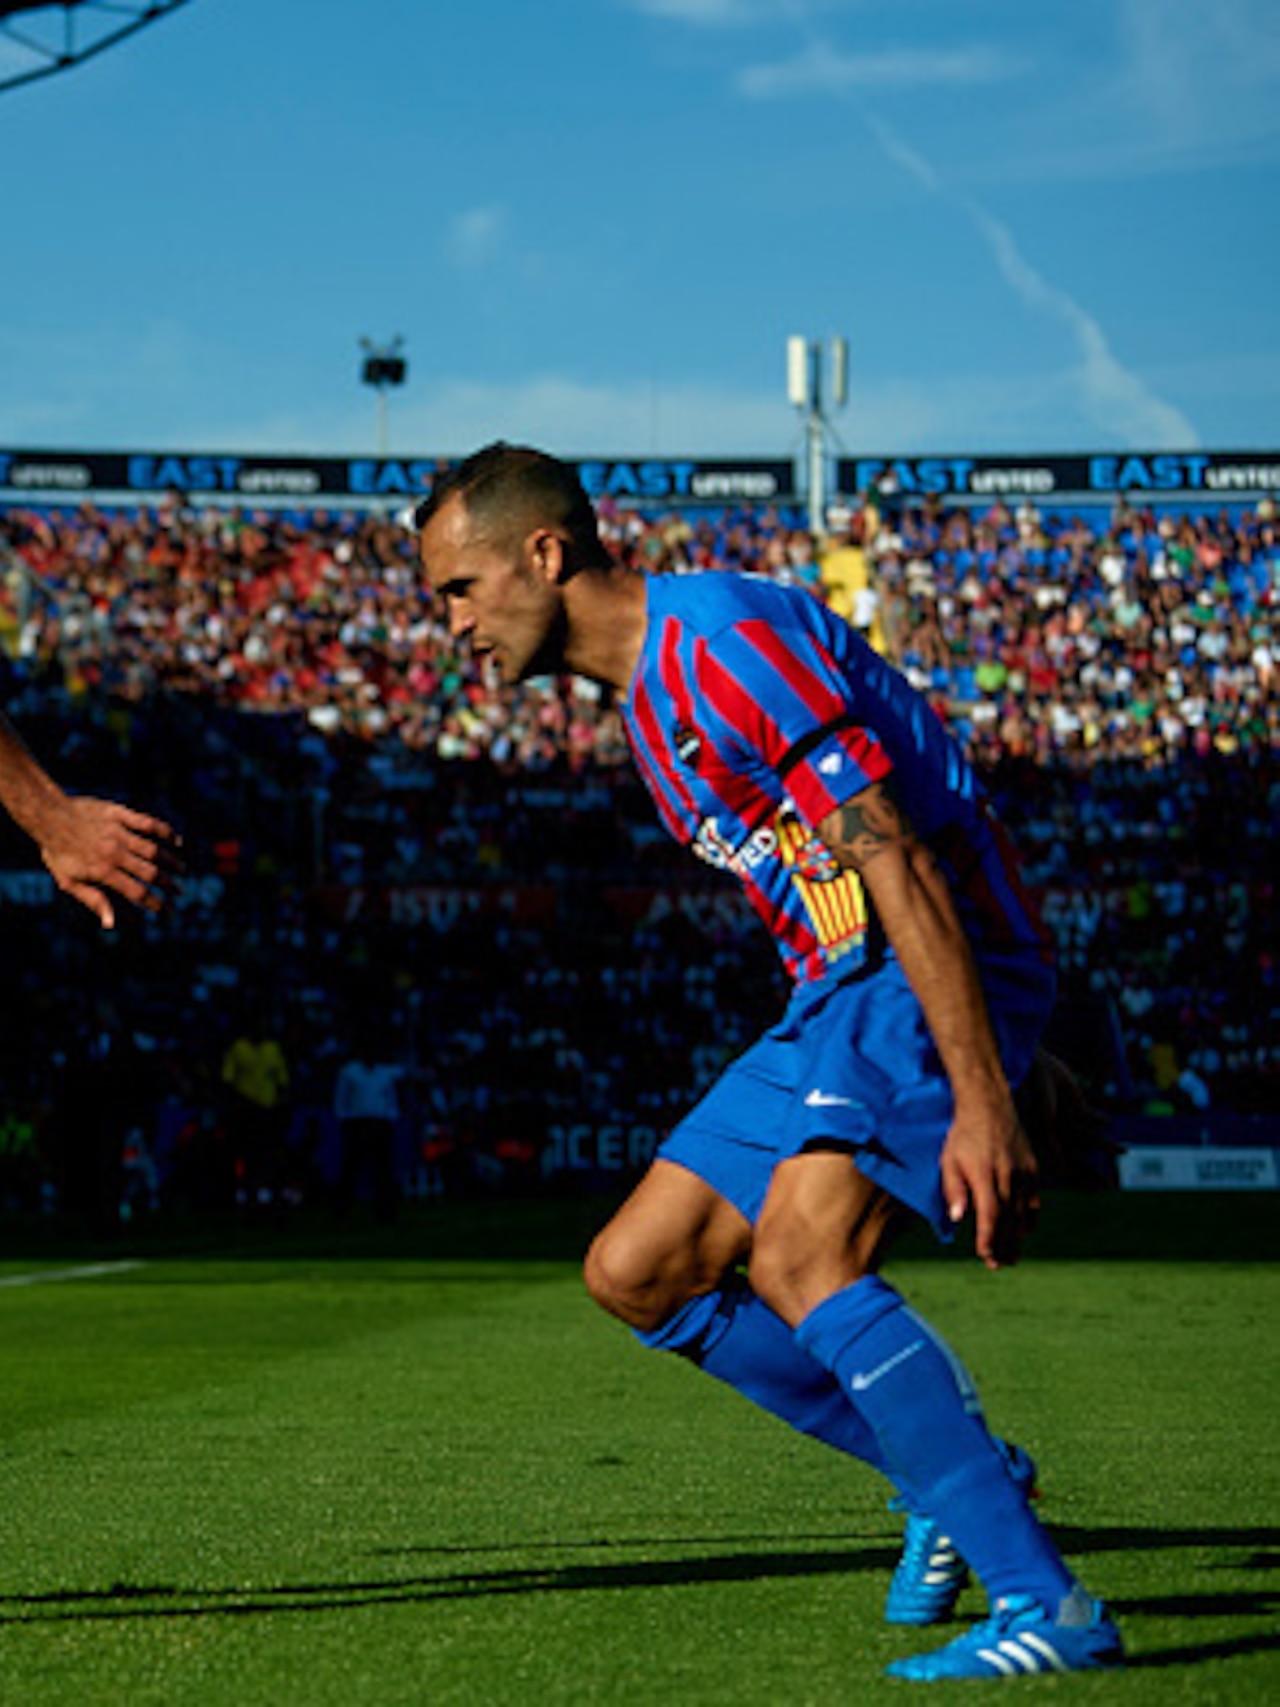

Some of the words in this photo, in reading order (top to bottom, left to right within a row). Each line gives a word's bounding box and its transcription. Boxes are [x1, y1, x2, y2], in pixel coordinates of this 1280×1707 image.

[127, 456, 241, 489] EAST
[348, 459, 458, 494] EAS
[579, 462, 695, 495] EAST
[1089, 456, 1212, 489] EAST
